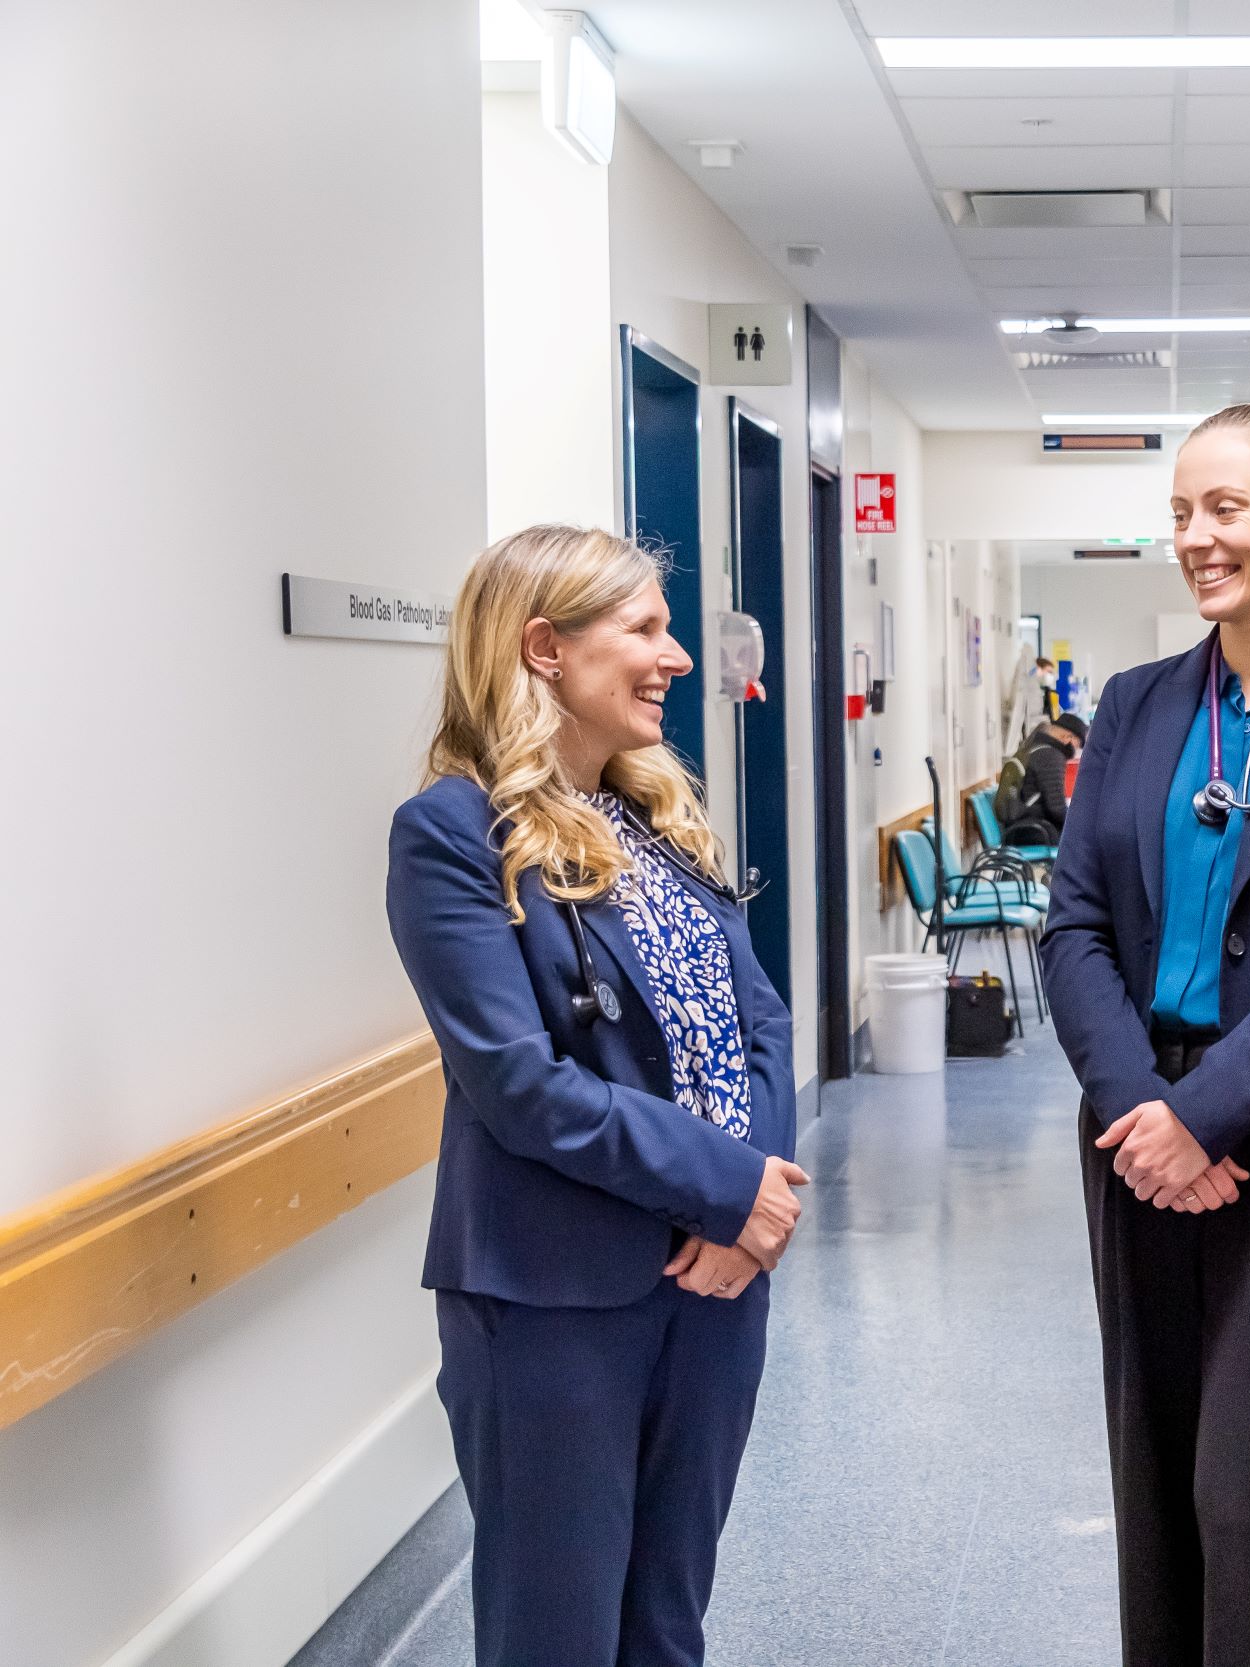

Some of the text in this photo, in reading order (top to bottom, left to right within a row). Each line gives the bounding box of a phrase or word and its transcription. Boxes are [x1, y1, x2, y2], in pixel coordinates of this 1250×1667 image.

[867, 510, 884, 520] FIRE
[349, 594, 374, 620] Blood
[376, 597, 392, 621] Gas
[397, 600, 433, 631] Pathology
